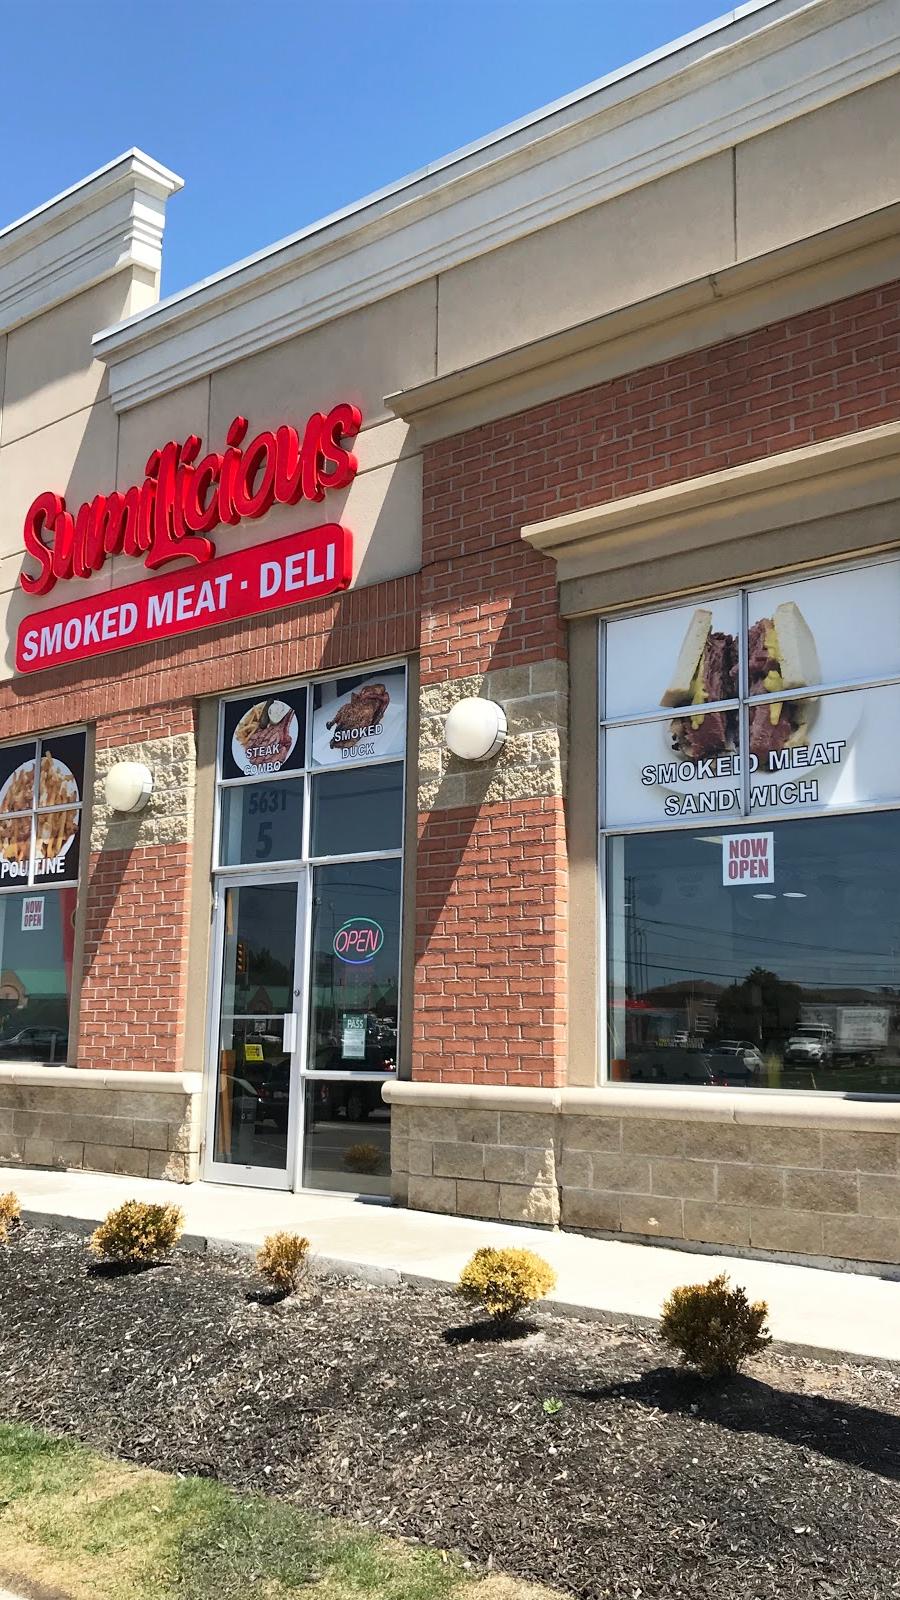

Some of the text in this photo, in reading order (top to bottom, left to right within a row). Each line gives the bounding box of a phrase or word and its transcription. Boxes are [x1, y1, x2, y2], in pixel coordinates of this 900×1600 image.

[22, 542, 336, 662] SMOKED MEAT DELI
[334, 723, 384, 743] SMOKED
[246, 743, 281, 760] STEAK
[341, 743, 375, 760] DUCK
[243, 762, 281, 776] COMBO
[641, 740, 847, 786] SMOKED MEAT
[248, 789, 288, 815] 5631
[664, 779, 819, 816] SANDWICH
[255, 821, 273, 859] 5
[728, 838, 769, 859] NOW
[0, 855, 66, 879] POUTINE
[728, 858, 769, 880] OPEN
[25, 900, 43, 914] NOW
[24, 913, 42, 927] OPEN
[335, 929, 379, 953] OPEN
[347, 1019, 364, 1029] PASS
